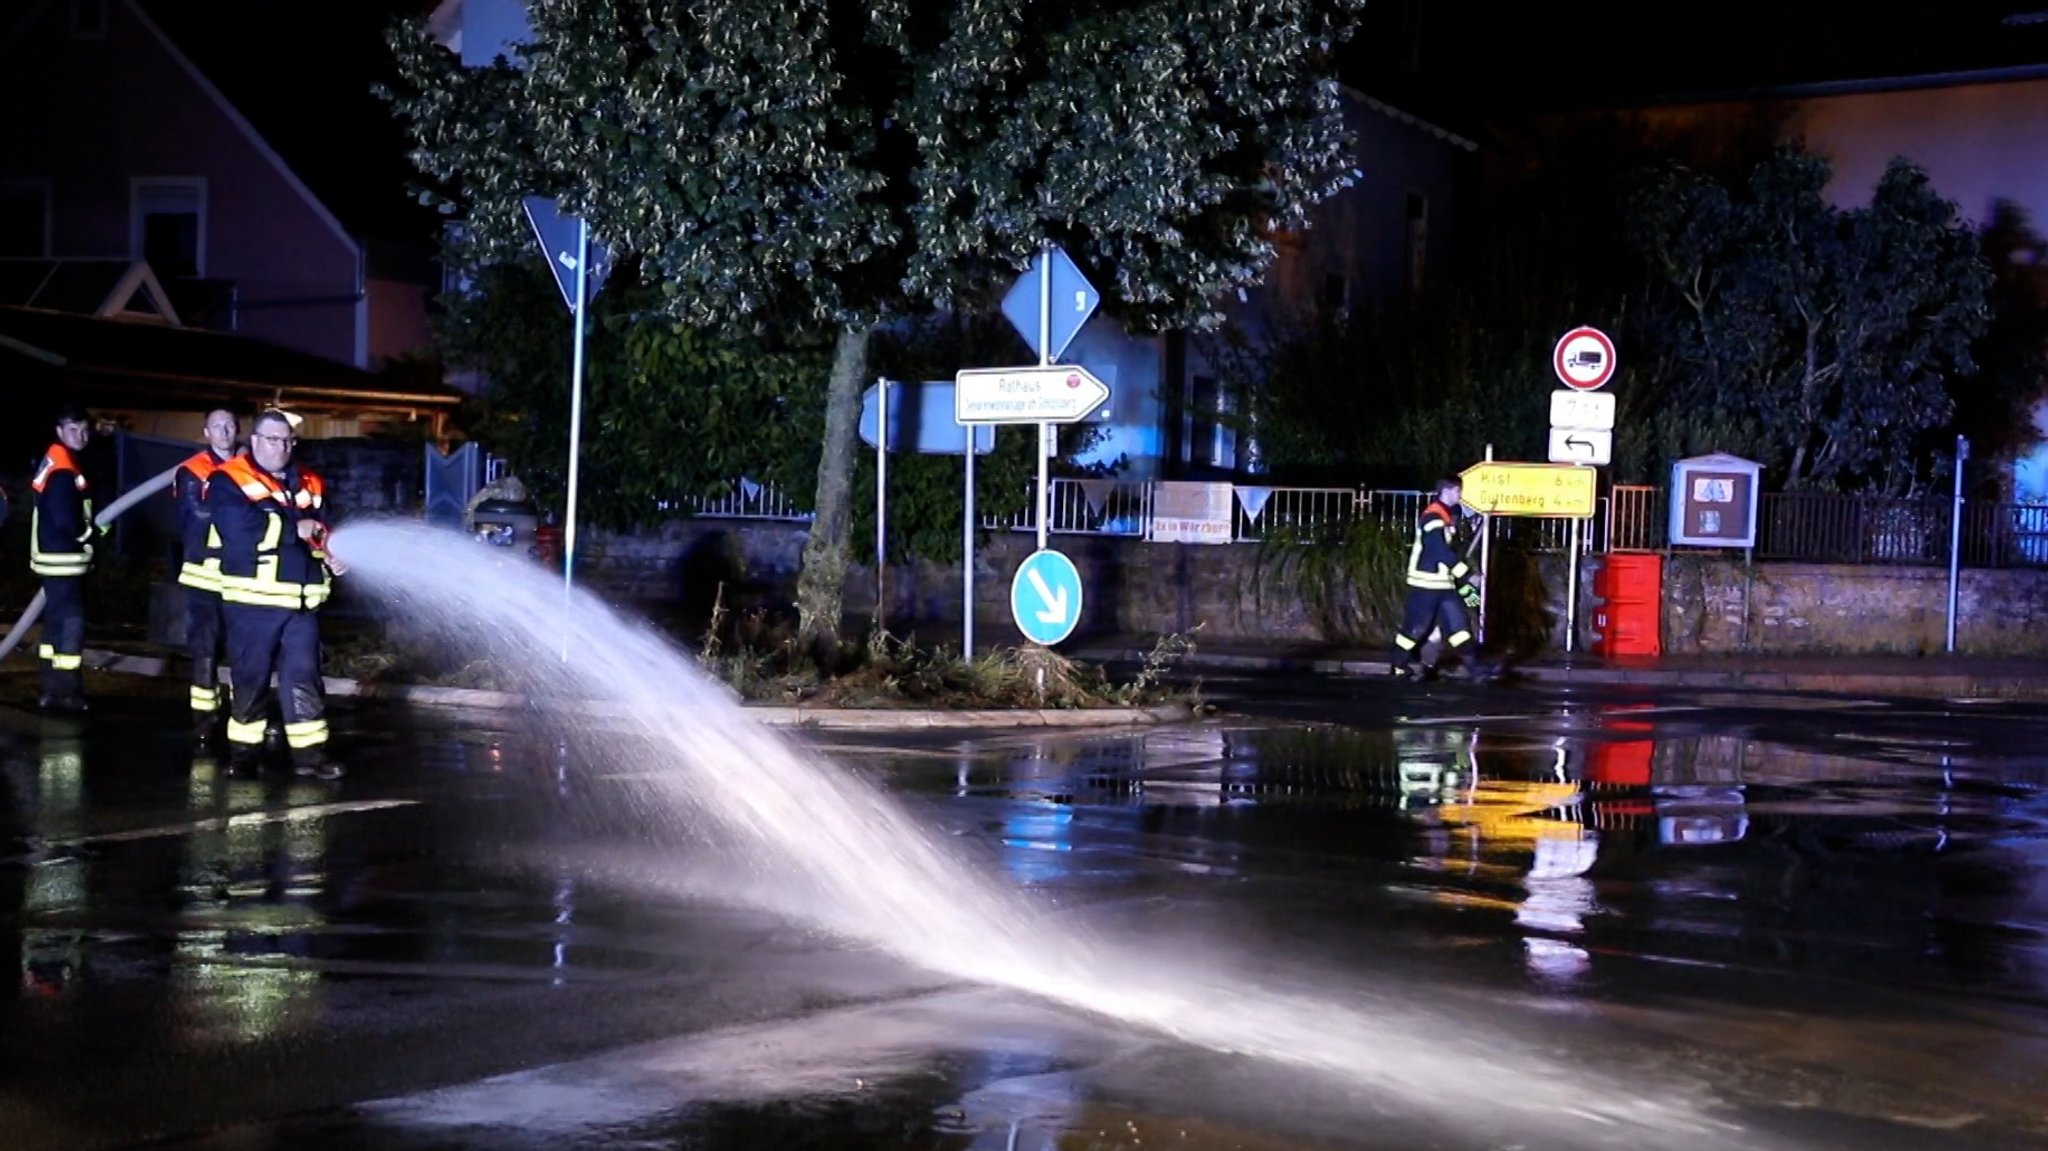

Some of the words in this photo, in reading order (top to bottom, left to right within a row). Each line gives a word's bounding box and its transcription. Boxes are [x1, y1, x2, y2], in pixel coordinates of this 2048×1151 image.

[998, 378, 1042, 393] Rathaus
[1481, 472, 1511, 485] Kist
[1555, 475, 1562, 486] 6
[1480, 490, 1545, 508] Guttenberg
[1553, 494, 1562, 505] 4
